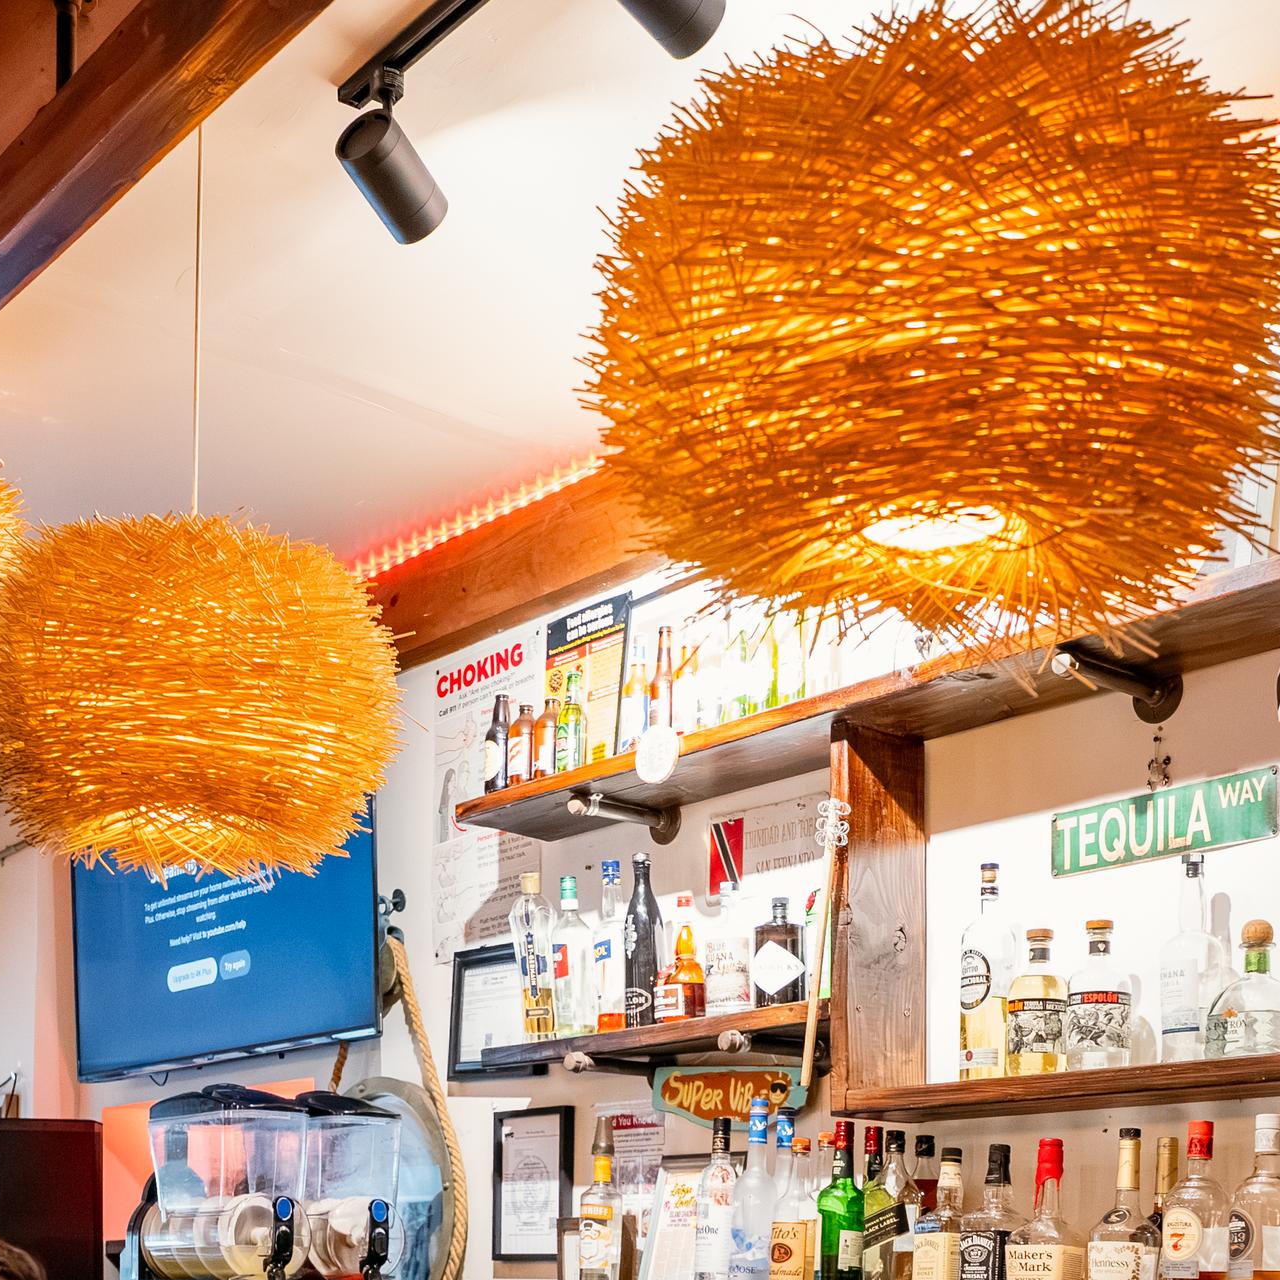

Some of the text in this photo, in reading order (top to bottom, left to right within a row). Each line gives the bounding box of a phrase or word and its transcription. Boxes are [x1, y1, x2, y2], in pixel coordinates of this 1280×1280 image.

[437, 643, 523, 698] CHOKING
[1057, 776, 1267, 870] TEQUILA WAY
[745, 824, 779, 850] TRINIDAD
[781, 821, 797, 842] AND
[1084, 992, 1117, 1003] ESPOLÓN
[960, 1236, 972, 1251] JACK
[1170, 1232, 1185, 1251] 7
[1009, 1250, 1053, 1260] Maker's
[1019, 1262, 1052, 1272] Mark
[1092, 1257, 1130, 1271] Hennessy
